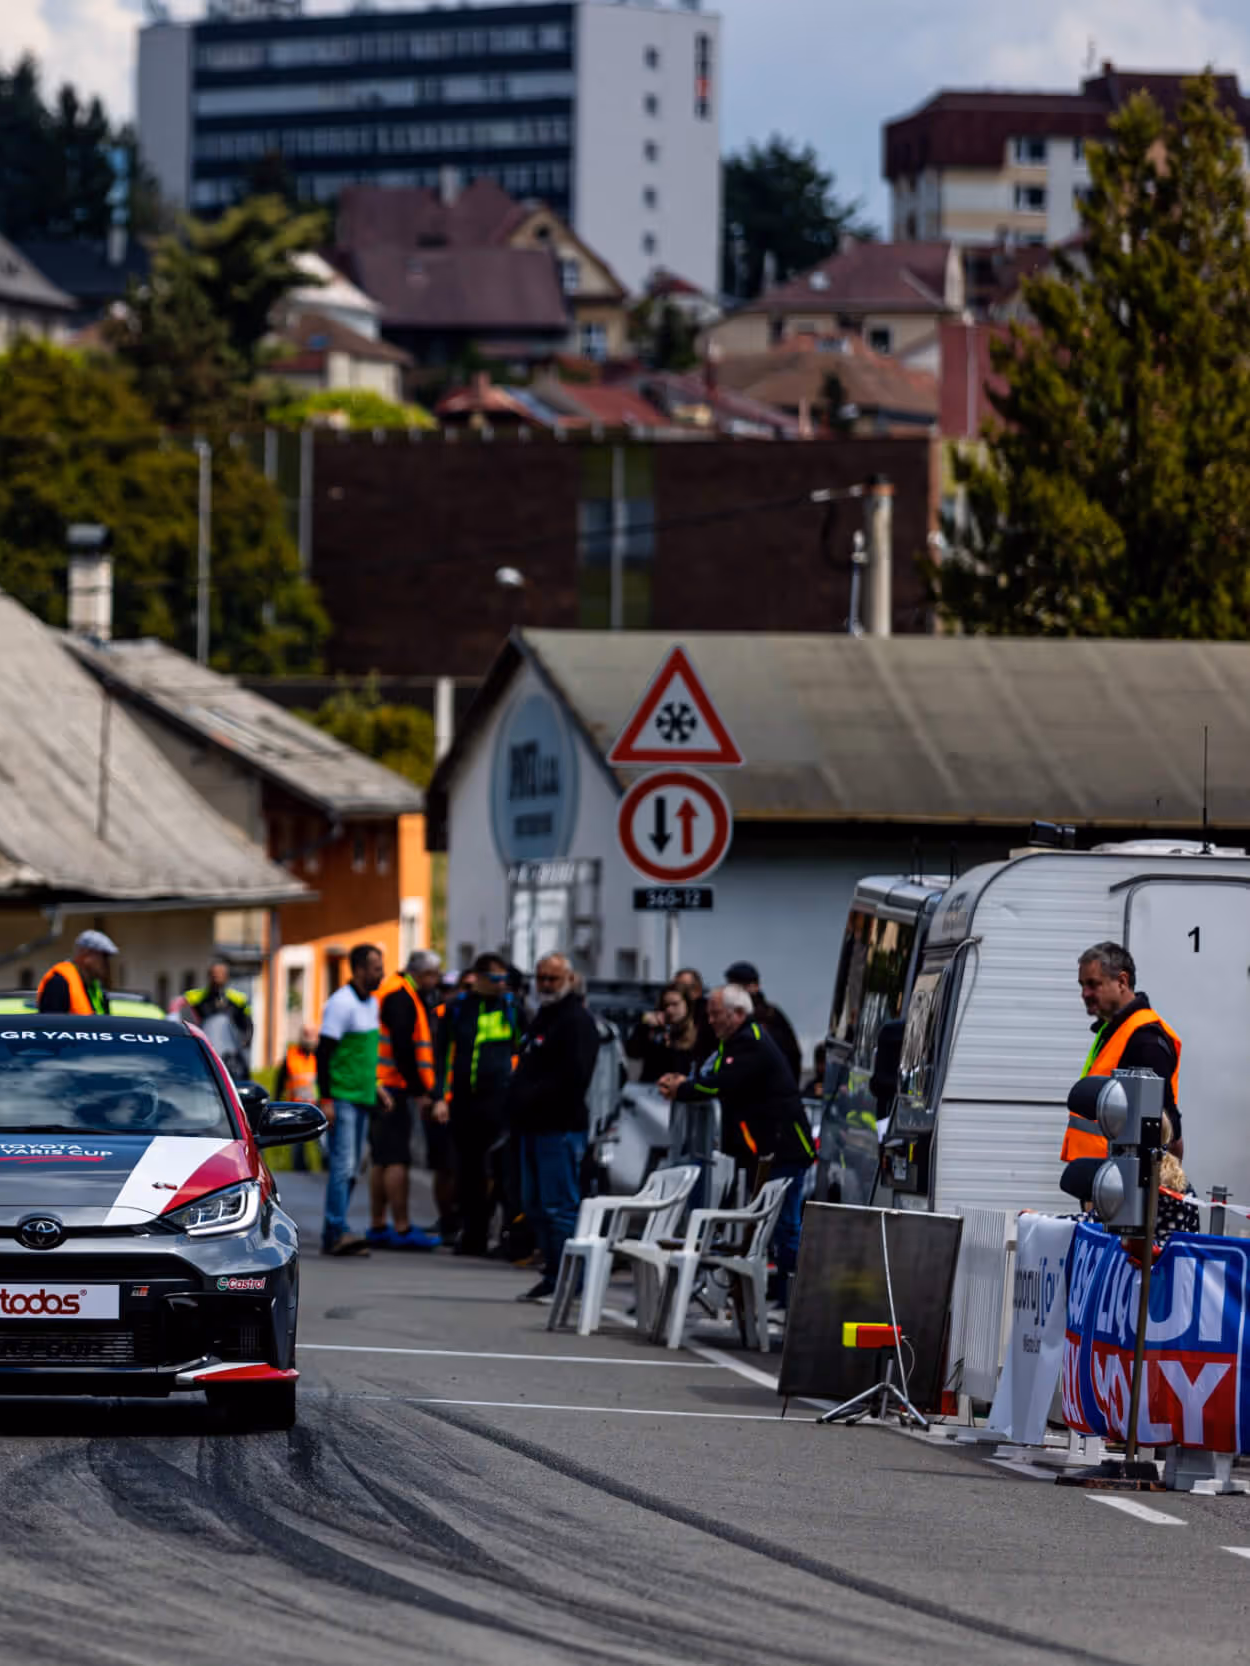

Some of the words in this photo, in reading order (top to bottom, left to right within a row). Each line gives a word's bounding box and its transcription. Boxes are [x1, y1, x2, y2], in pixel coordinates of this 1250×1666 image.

[1188, 926, 1200, 952] 1
[0, 1031, 36, 1040] GR
[42, 1031, 113, 1042] YARIS
[119, 1033, 170, 1044] CUP
[3, 1148, 63, 1156] YARIS
[68, 1149, 113, 1157] CUP
[229, 1277, 266, 1289] Castrol
[1096, 1251, 1227, 1346] LIQUI
[1093, 1352, 1232, 1445] MOLY
